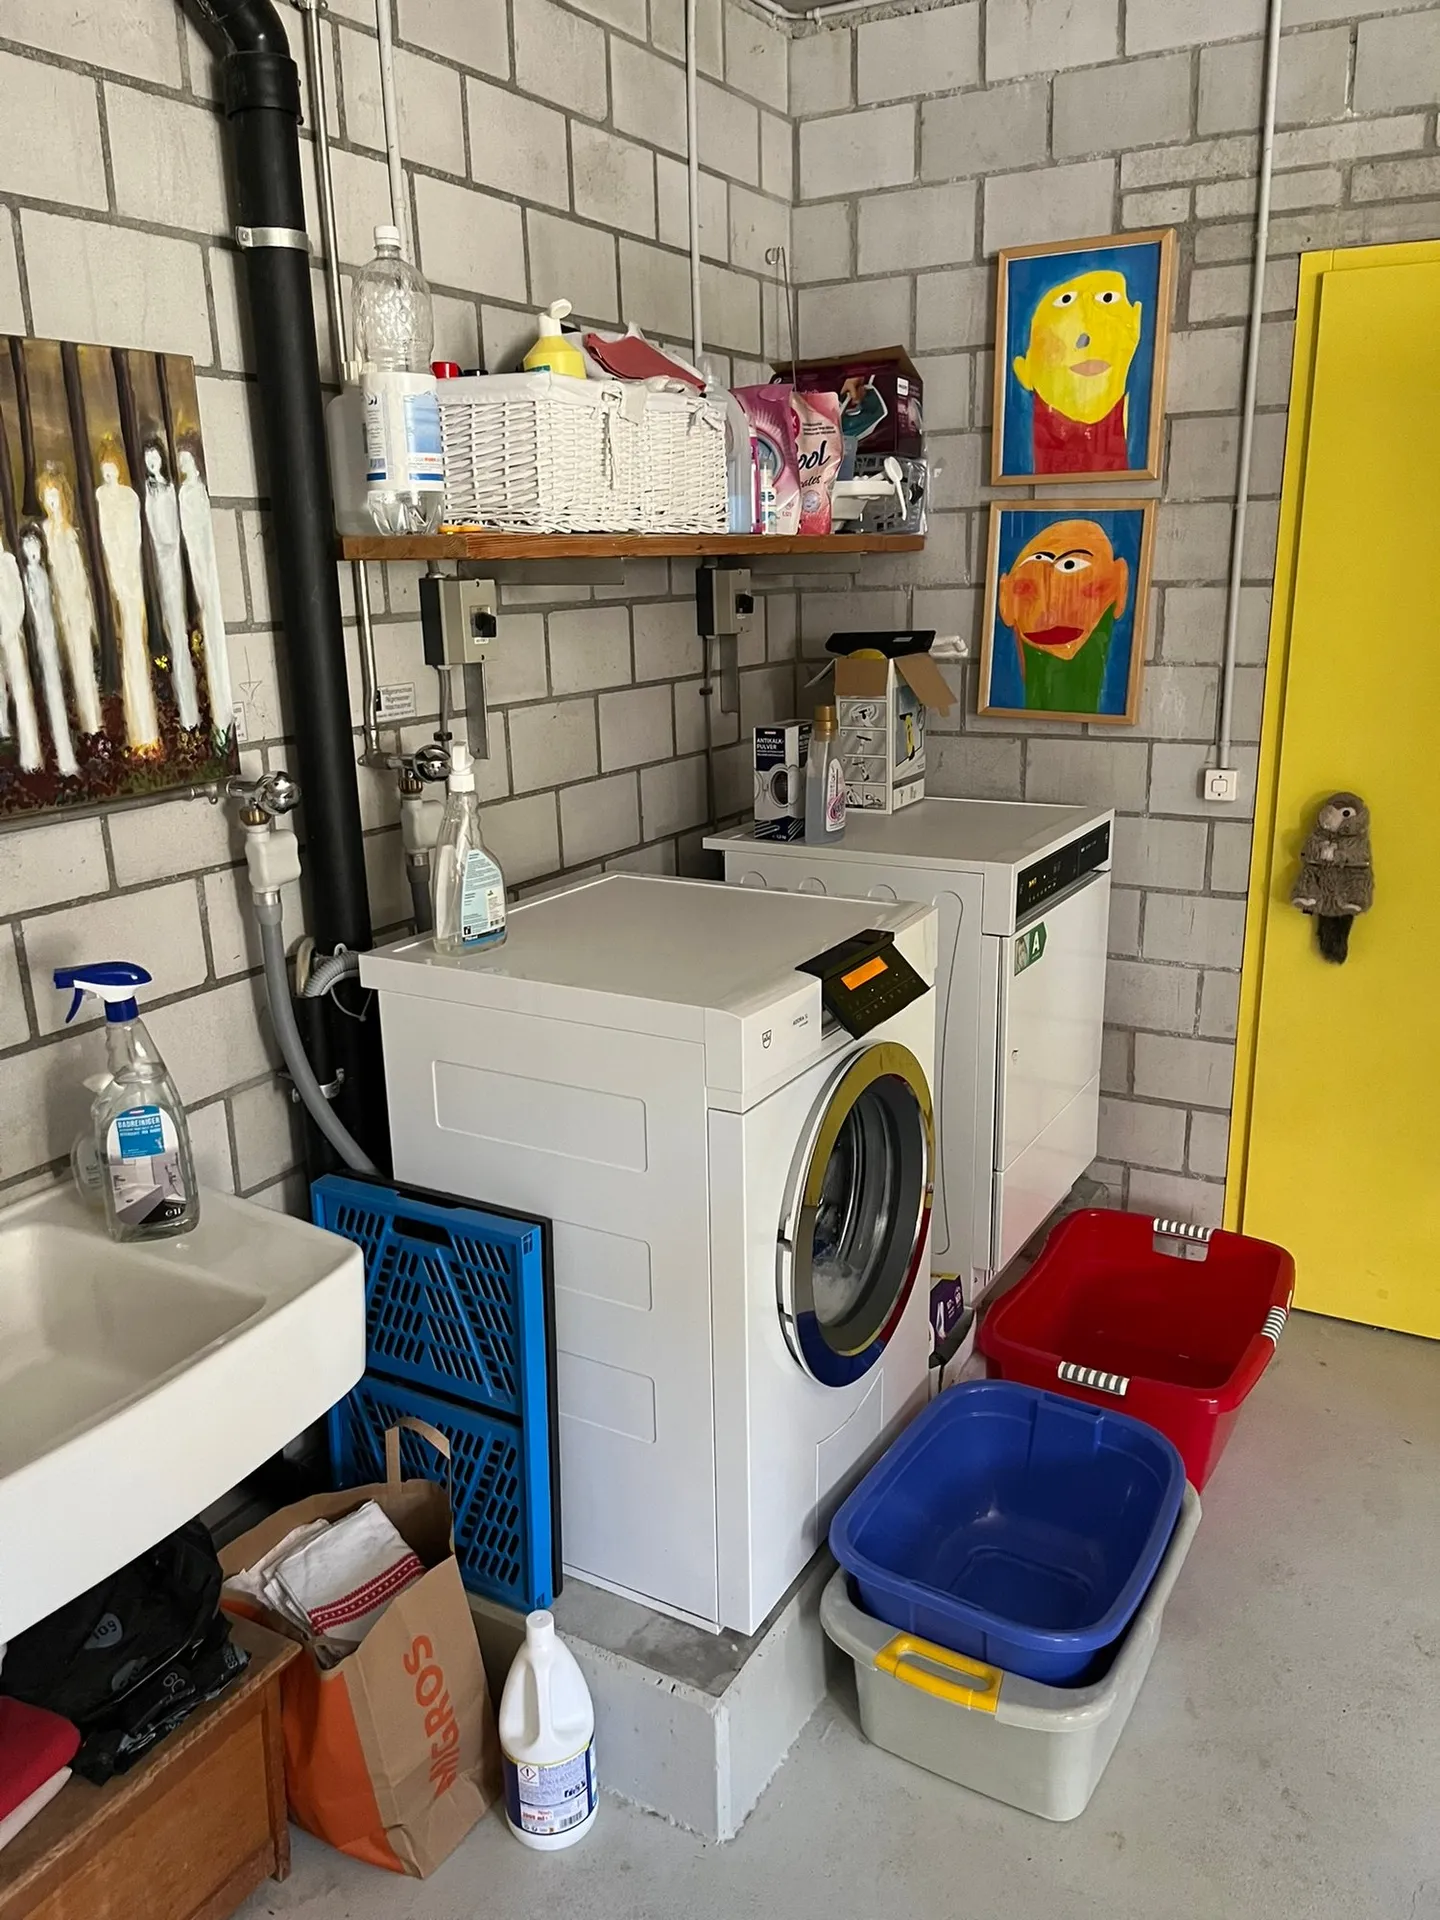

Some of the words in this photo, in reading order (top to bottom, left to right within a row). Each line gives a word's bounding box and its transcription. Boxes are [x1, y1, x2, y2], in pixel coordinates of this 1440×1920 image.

[796, 440, 831, 470] ool
[1031, 931, 1041, 955] A
[117, 1116, 161, 1129] BADREINIGER
[403, 1635, 460, 1801] MIGROS
